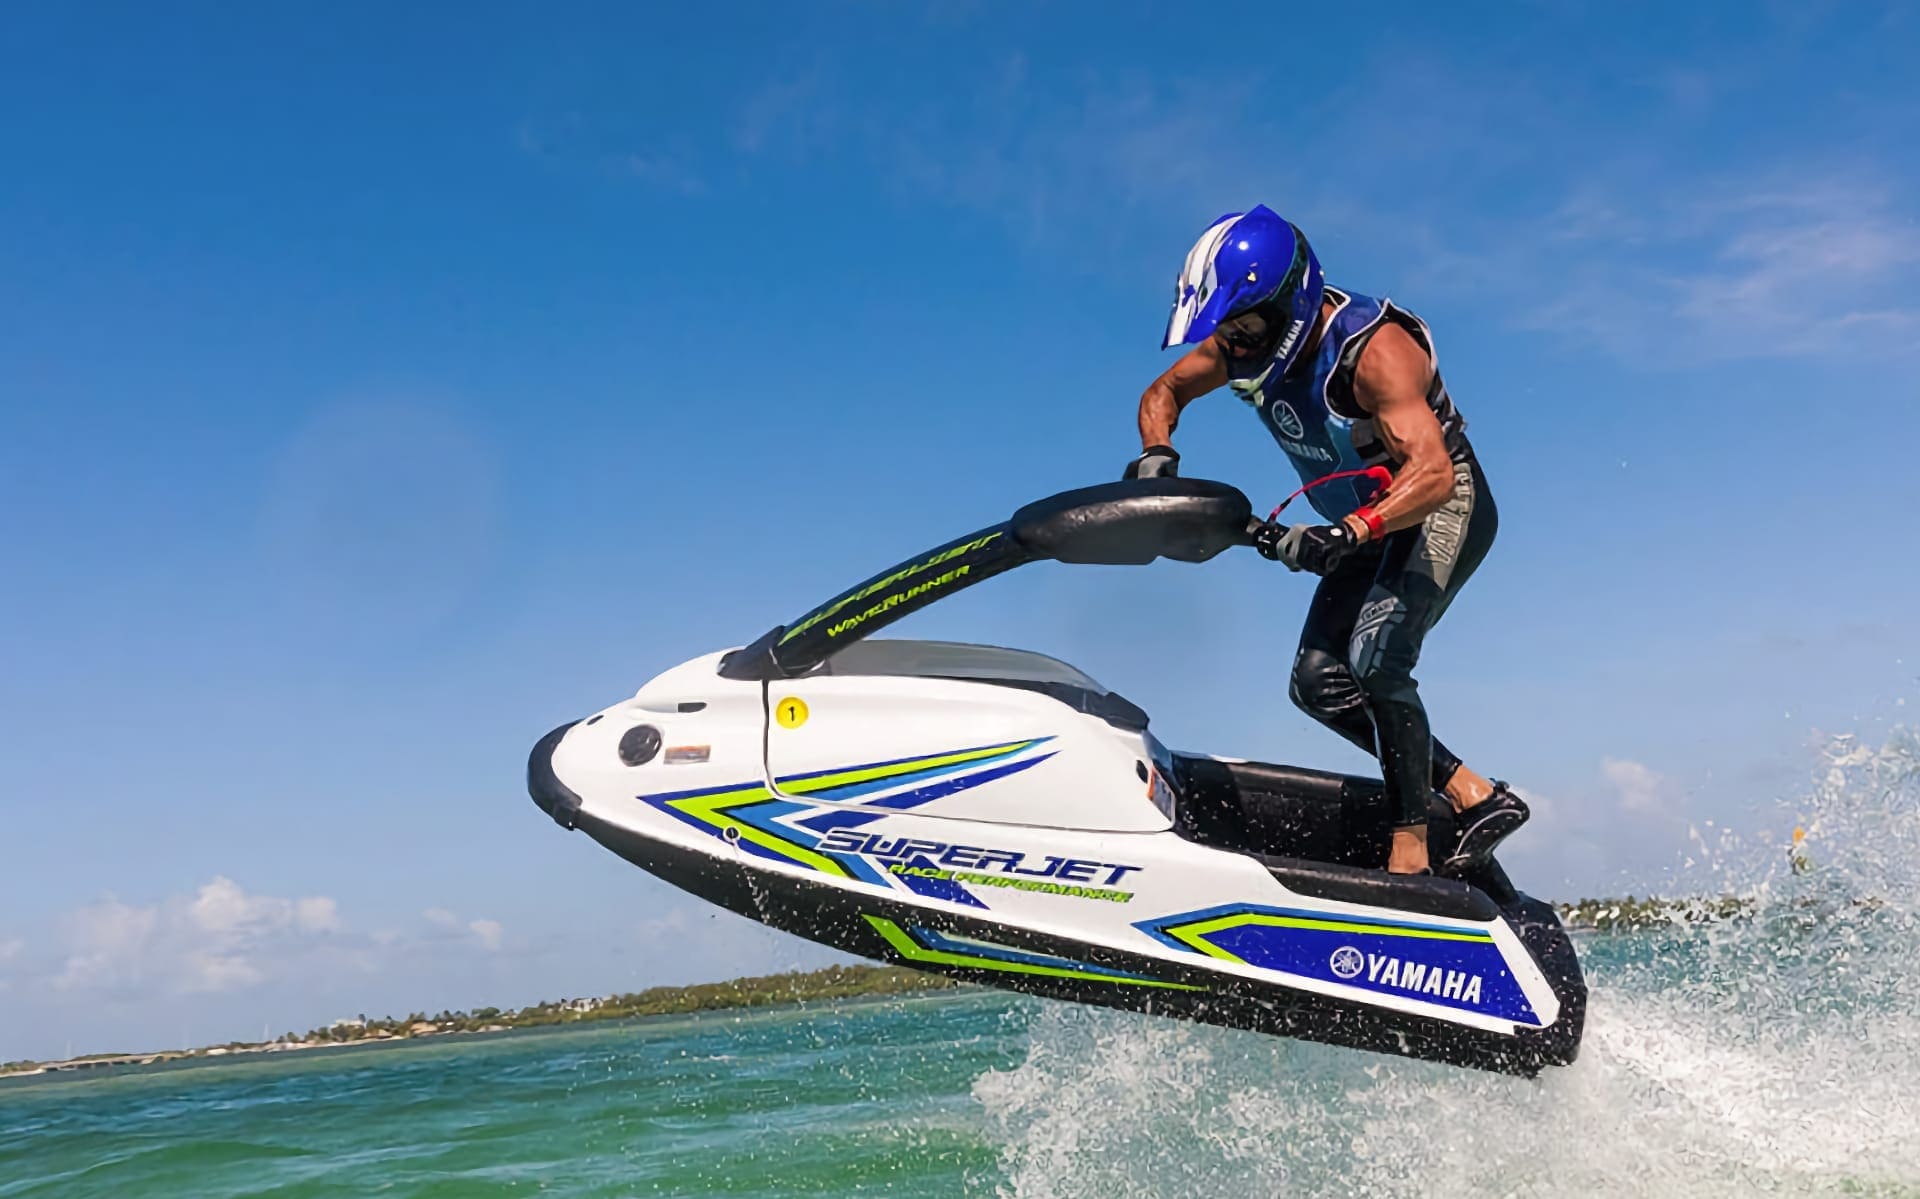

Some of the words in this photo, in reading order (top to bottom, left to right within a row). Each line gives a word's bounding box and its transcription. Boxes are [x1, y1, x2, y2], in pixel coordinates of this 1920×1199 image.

[1275, 319, 1304, 359] YAMAHA
[788, 706, 795, 722] 1
[820, 828, 1143, 885] SUPERJET
[888, 864, 954, 880] RACE
[1367, 953, 1482, 1004] YAMAHA
